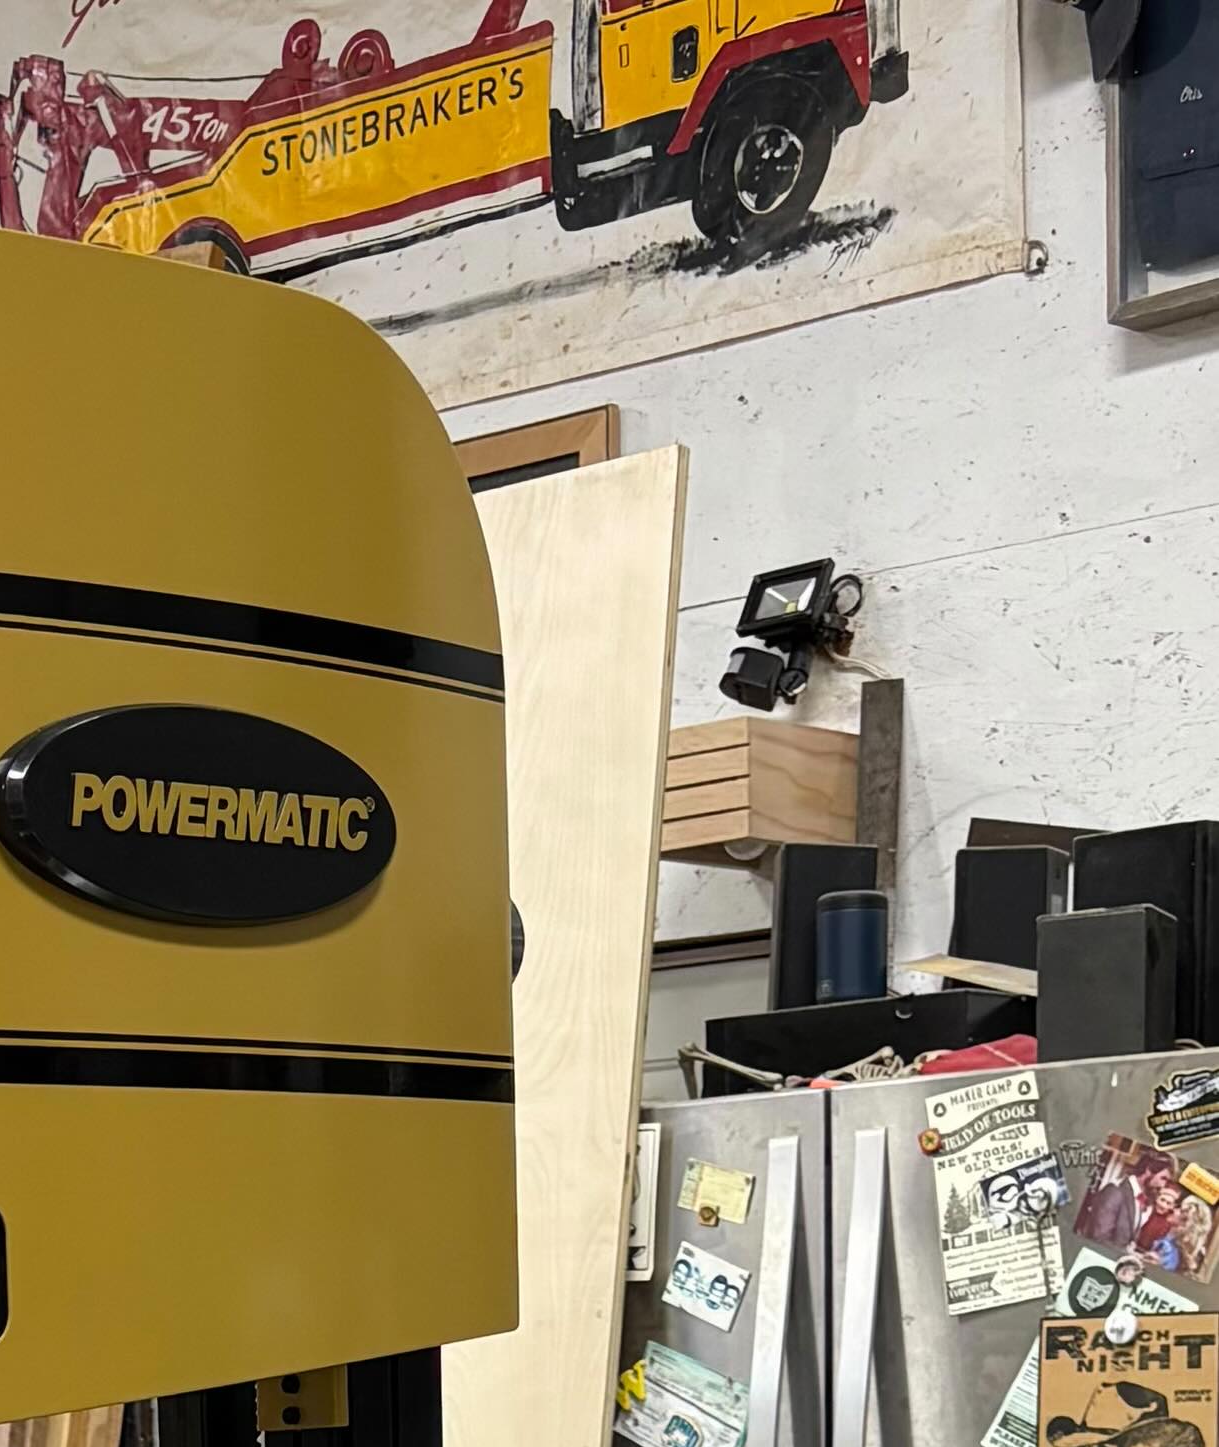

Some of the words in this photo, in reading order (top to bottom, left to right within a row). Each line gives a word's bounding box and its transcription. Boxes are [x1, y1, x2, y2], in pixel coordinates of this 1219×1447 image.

[261, 66, 525, 177] STONEBRAKER'S
[949, 1087, 983, 1107] MAKER
[986, 1079, 1013, 1097] CAMP
[991, 1104, 1037, 1125] TOOLS
[937, 1153, 968, 1171] NEW
[964, 1159, 992, 1175] OLD
[1045, 1325, 1170, 1360] RACH
